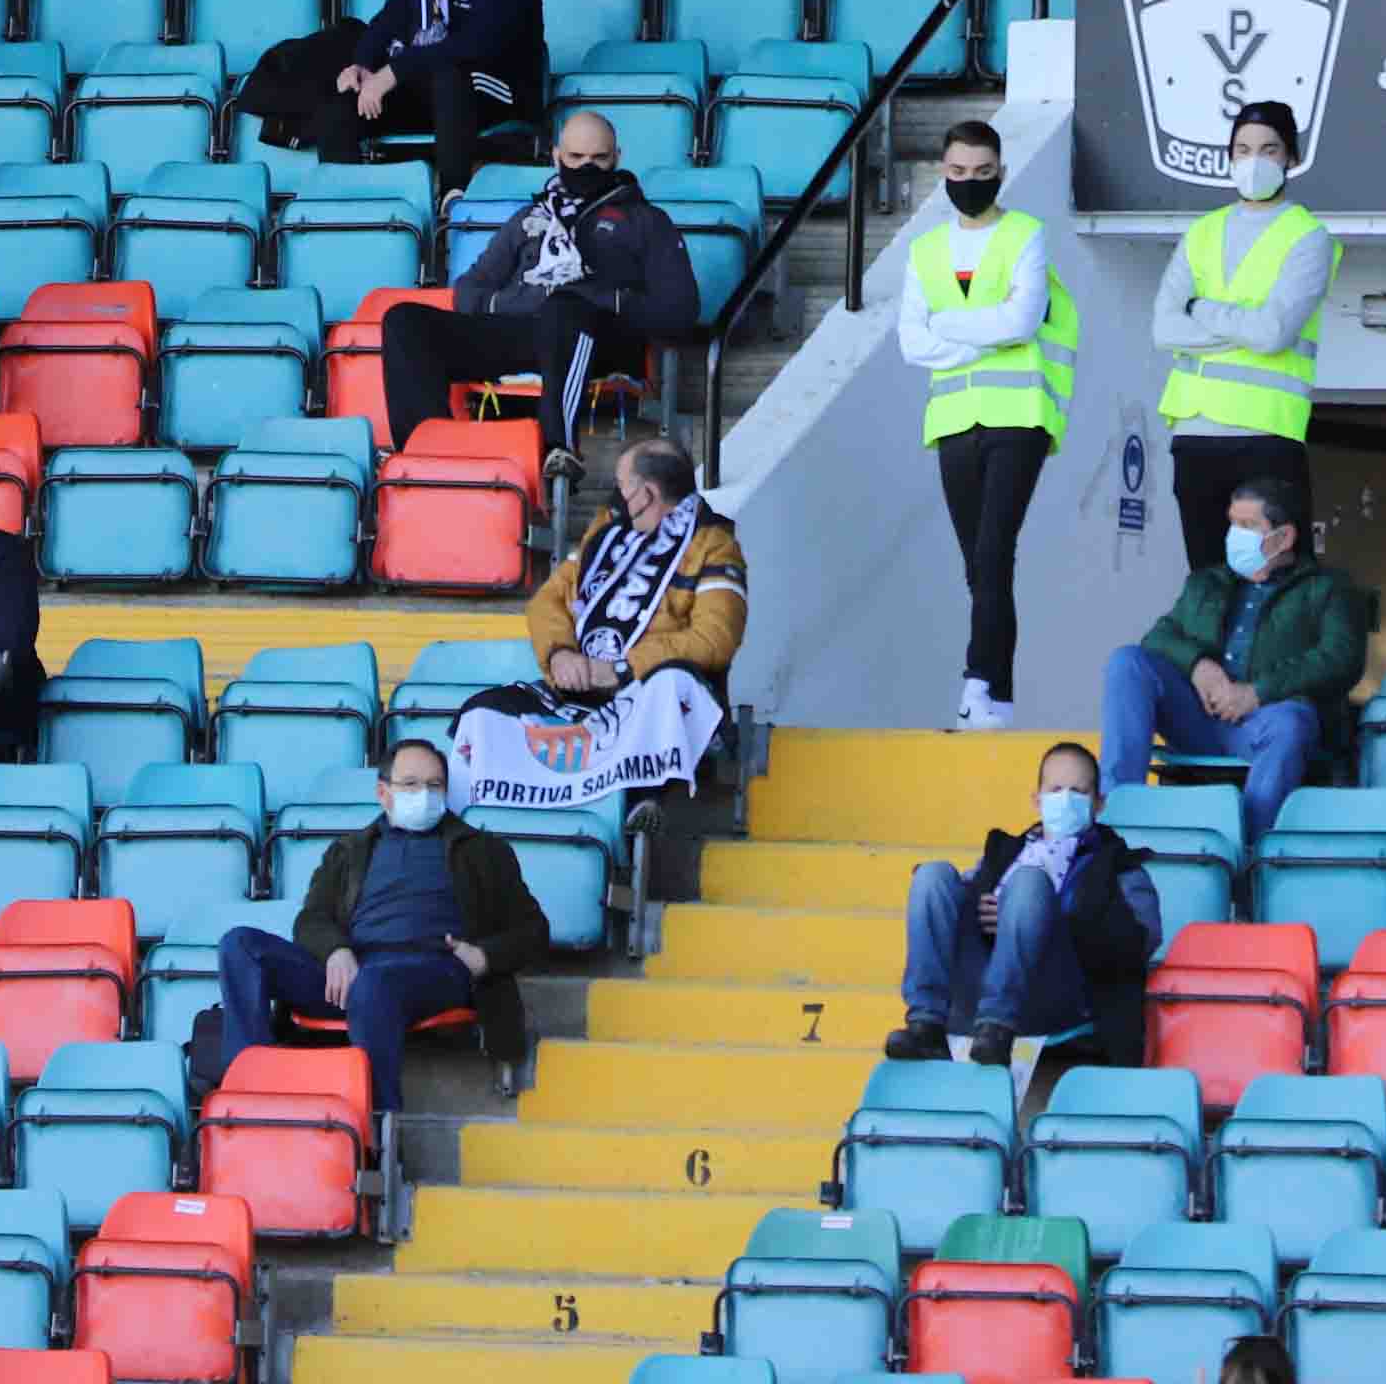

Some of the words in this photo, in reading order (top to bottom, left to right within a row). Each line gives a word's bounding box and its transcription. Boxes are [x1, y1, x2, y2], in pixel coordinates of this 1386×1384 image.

[801, 1004, 823, 1041] 7
[686, 1150, 711, 1185] 6
[552, 1295, 579, 1331] 5
